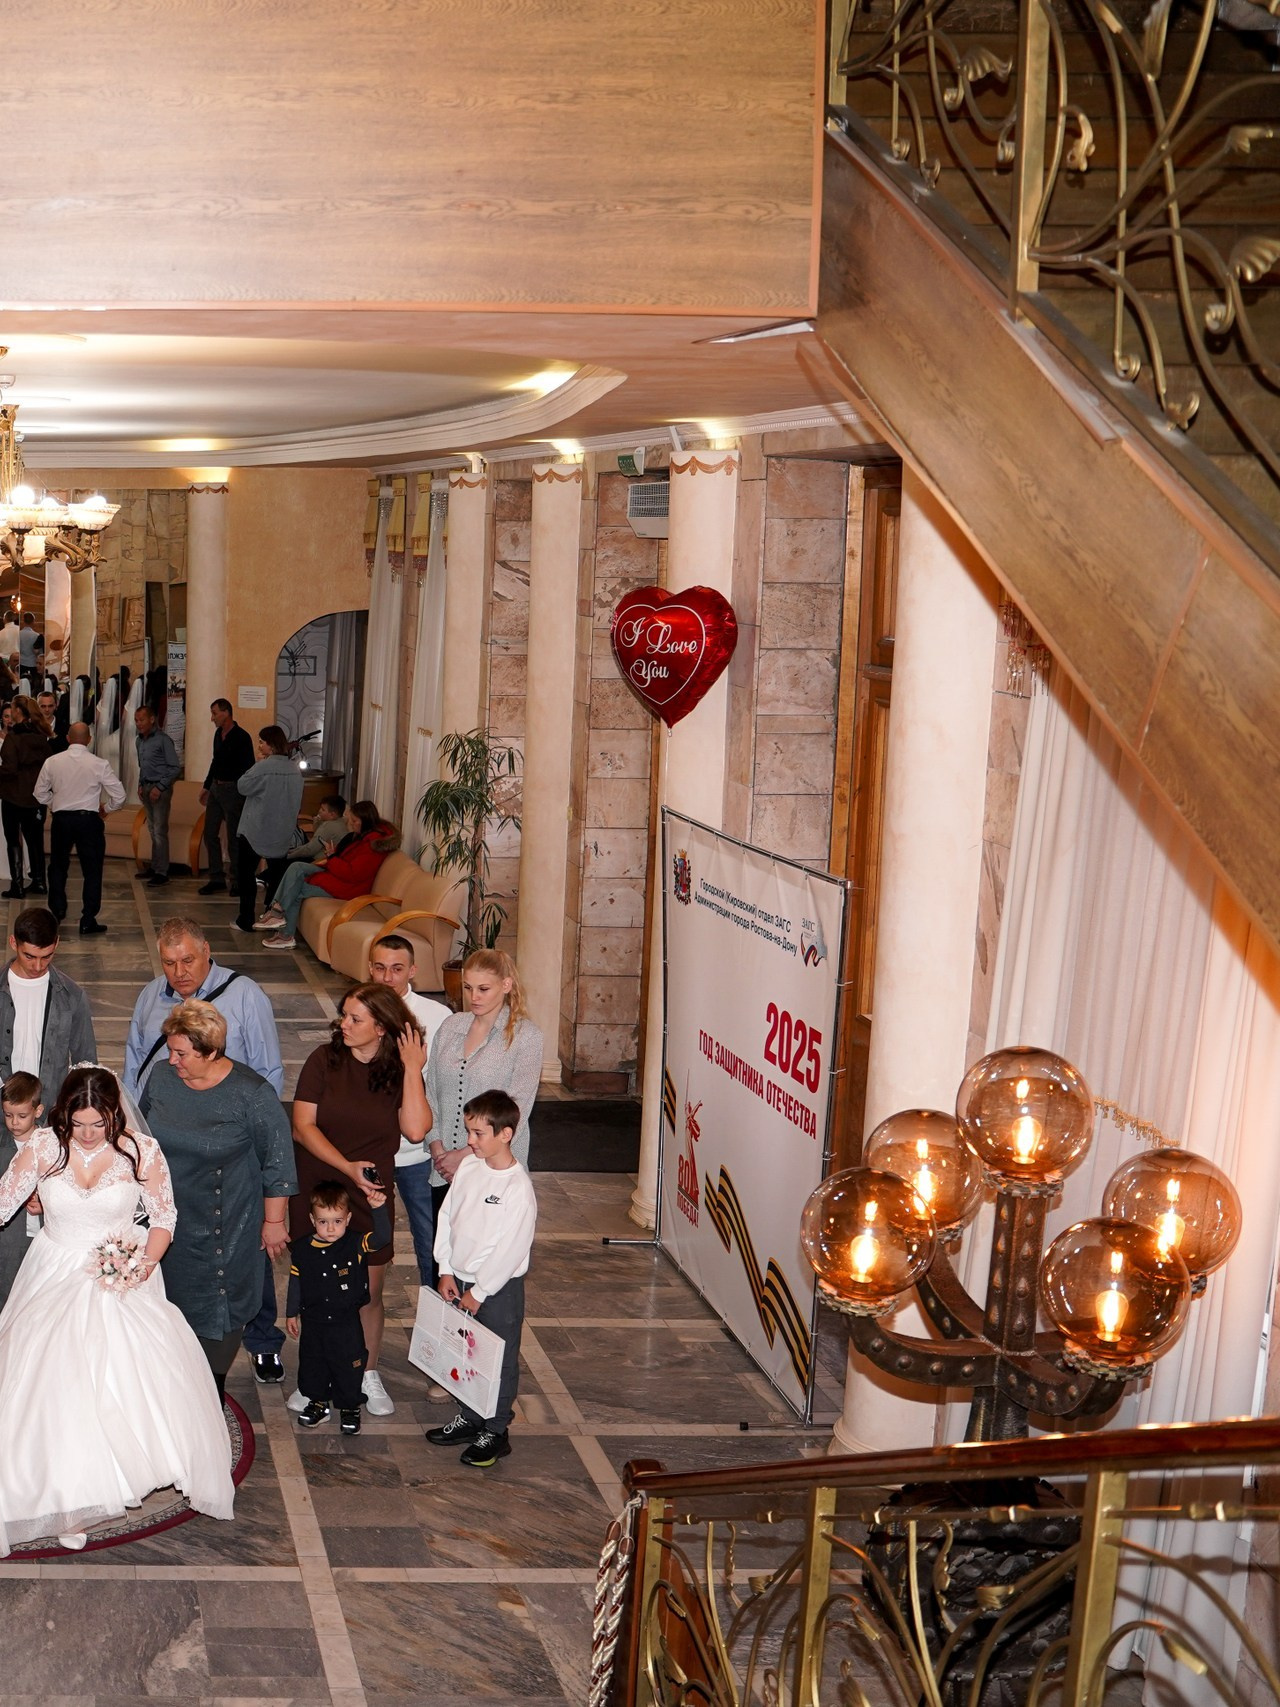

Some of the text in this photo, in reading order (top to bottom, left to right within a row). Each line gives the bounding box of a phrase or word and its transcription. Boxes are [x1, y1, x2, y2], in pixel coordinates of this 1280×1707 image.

[620, 617, 698, 654] I Love
[630, 659, 669, 688] You
[694, 891, 798, 957] Администрации города Ростова-на-Дону
[700, 878, 792, 933] Городской (Кировский) отдел ЗАГС
[801, 917, 816, 933] ЗАГС
[764, 1002, 822, 1093] 2025
[699, 1029, 816, 1140] ГОД ЗАЩИТНИКА ОТЕЧЕСТВА
[677, 1191, 699, 1229] ПОБЕДА!
